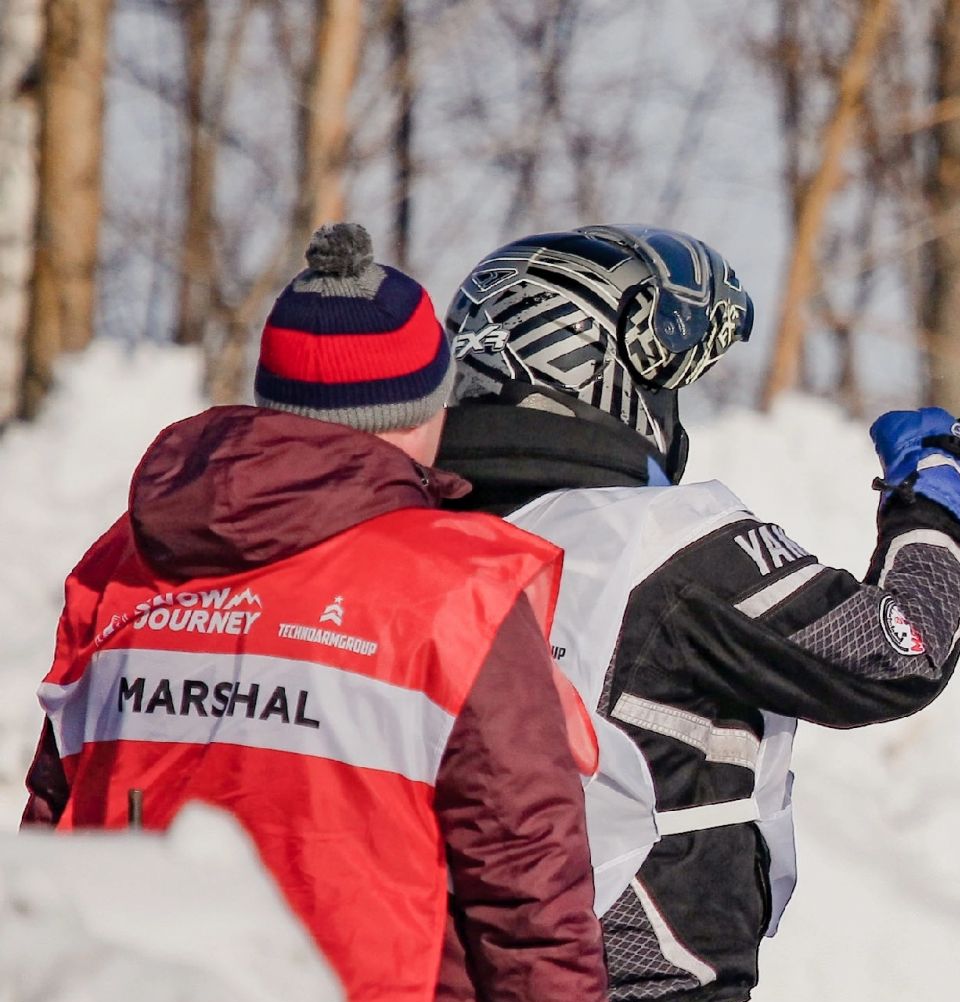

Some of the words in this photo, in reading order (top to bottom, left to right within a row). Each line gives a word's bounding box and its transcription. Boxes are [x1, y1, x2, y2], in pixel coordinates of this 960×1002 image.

[452, 325, 510, 360] FXR
[133, 608, 261, 635] JOURNEY
[278, 623, 378, 656] TECHNOARMGROUP
[117, 676, 320, 729] MARSHAL
